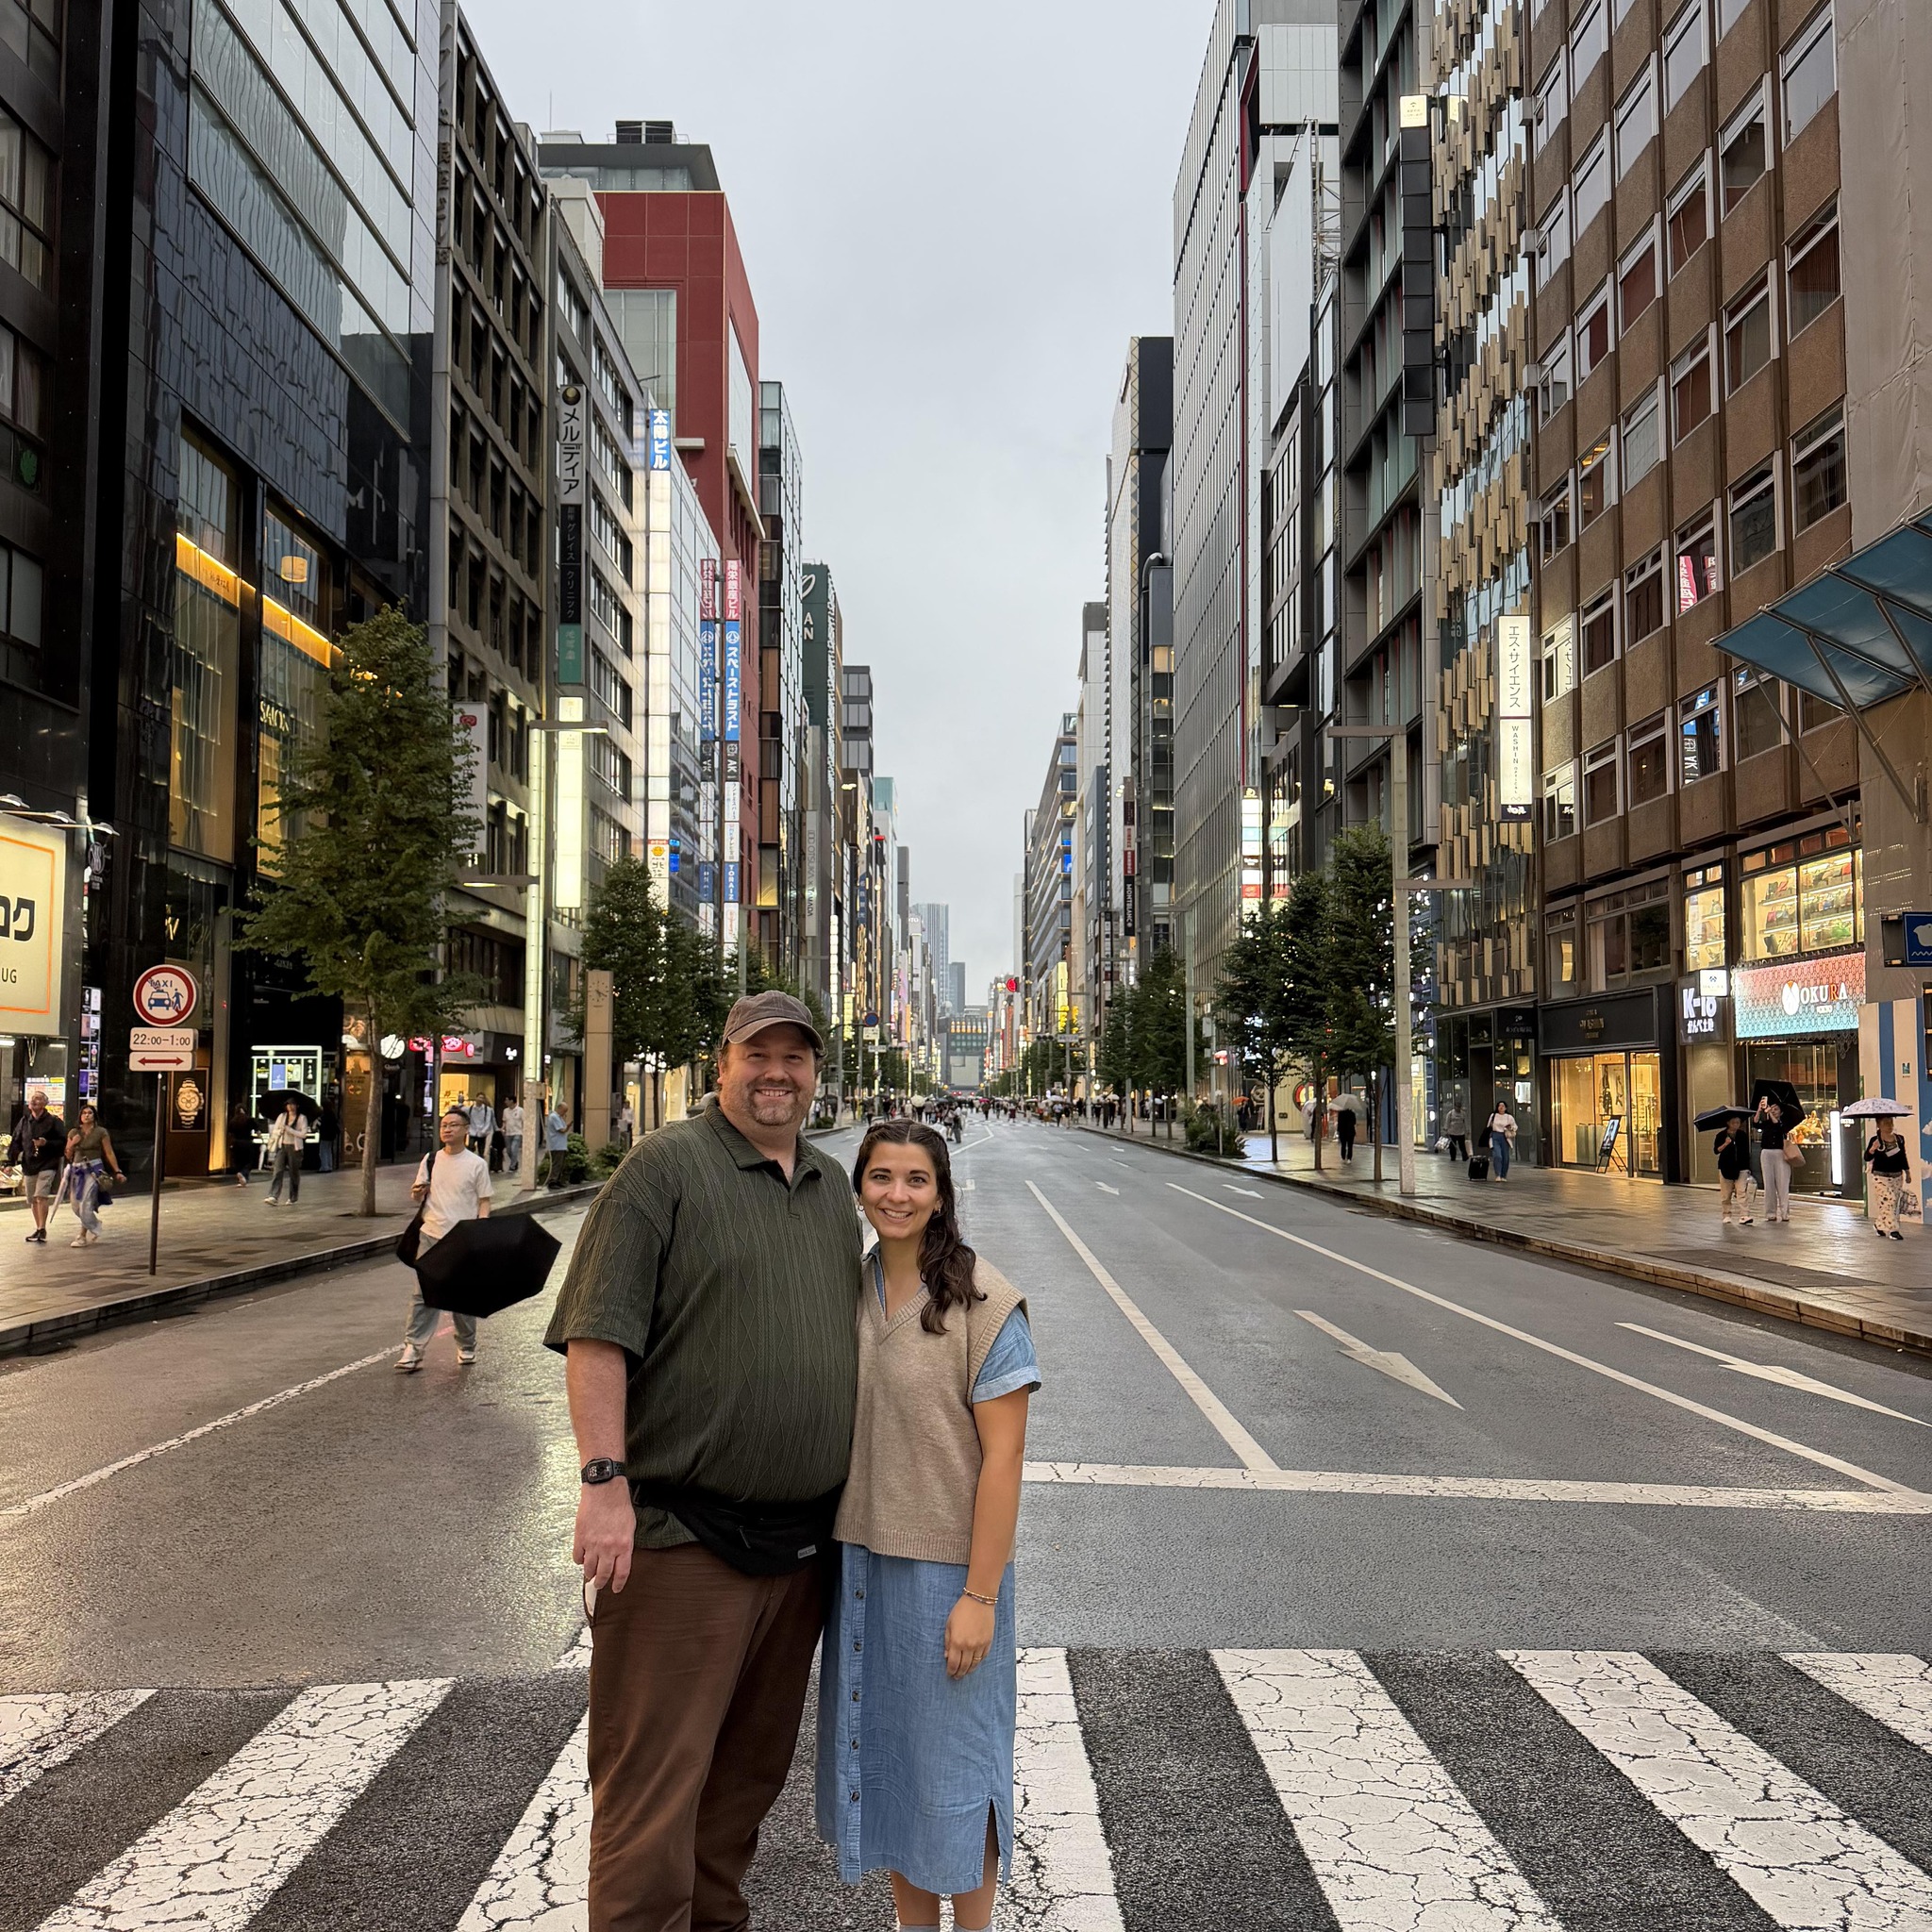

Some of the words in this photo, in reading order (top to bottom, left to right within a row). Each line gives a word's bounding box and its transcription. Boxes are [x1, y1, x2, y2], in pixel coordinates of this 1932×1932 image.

[563, 408, 580, 494] メルディア
[653, 409, 668, 469] 太陽ビル
[727, 646, 739, 731] スペーストラスト
[1508, 626, 1521, 708] エス・サイエンス
[1, 968, 17, 983] UG
[1800, 982, 1848, 1005] OKURA
[132, 1033, 191, 1046] 22:00-1:00
